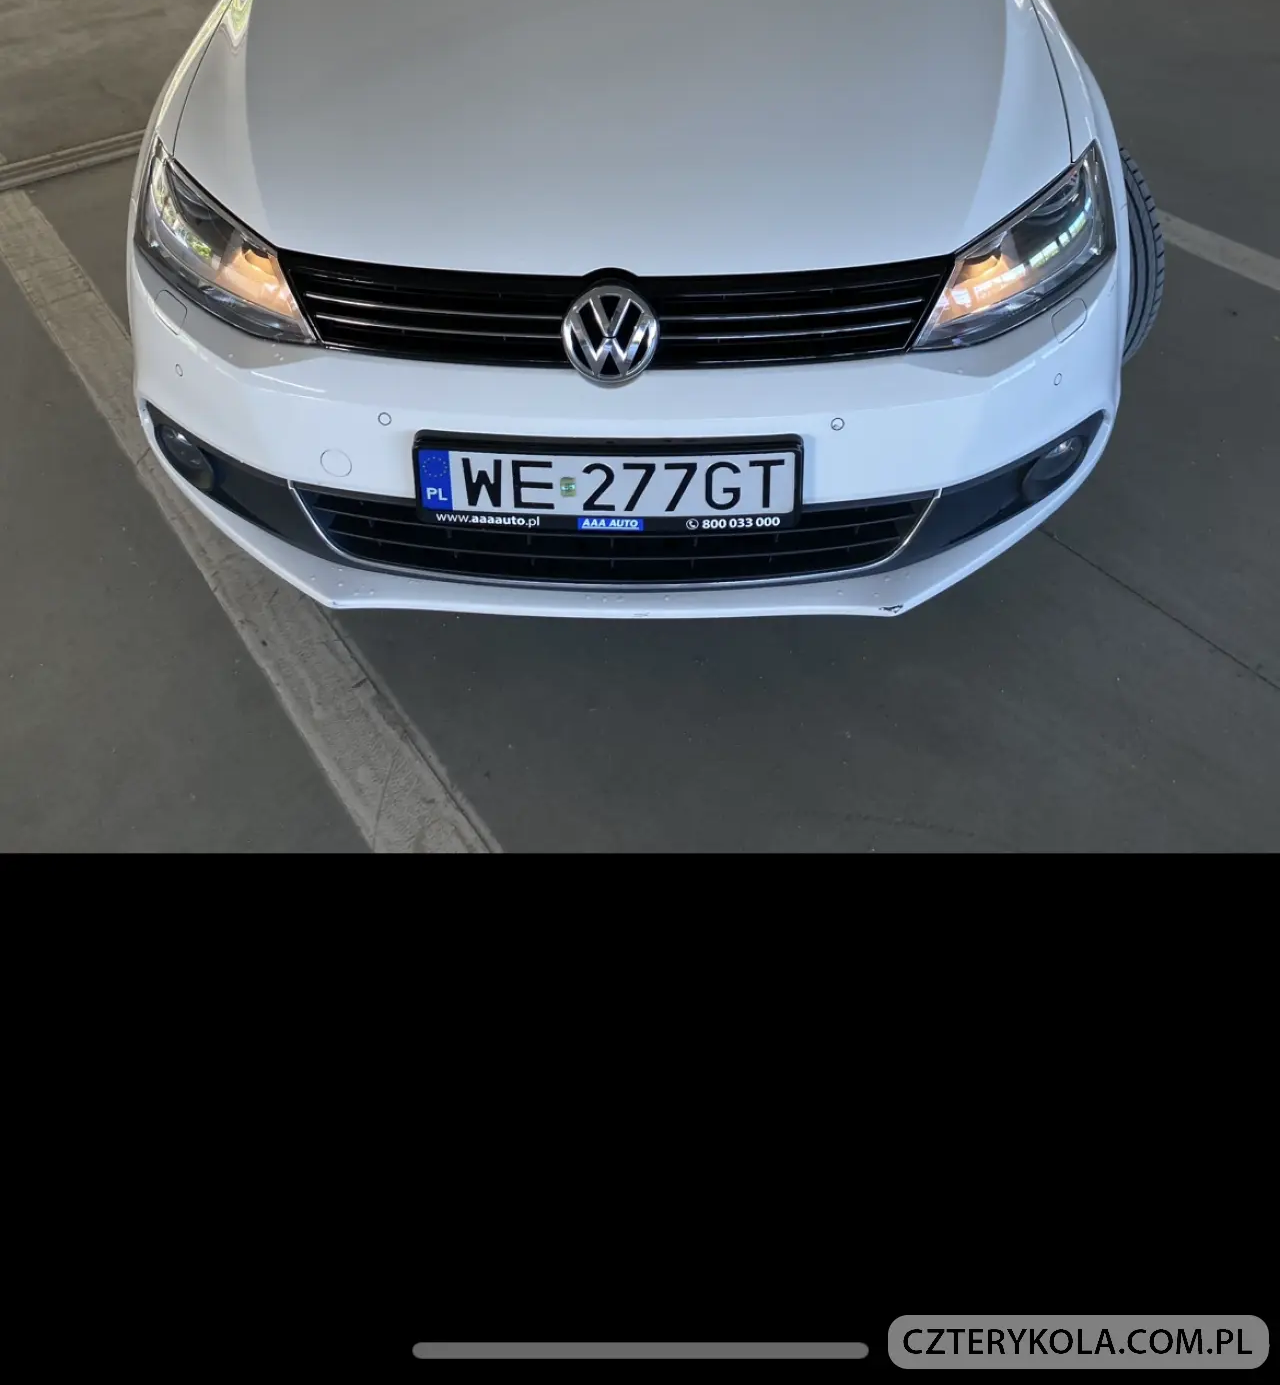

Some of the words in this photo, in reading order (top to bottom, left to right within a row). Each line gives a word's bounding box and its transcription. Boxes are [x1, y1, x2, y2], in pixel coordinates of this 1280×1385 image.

[561, 285, 660, 382] VW
[461, 456, 555, 510] WE
[582, 459, 785, 512] 277GT
[426, 487, 449, 502] PL
[436, 512, 540, 528] www.aaaauto.pl
[581, 518, 608, 530] AAA
[609, 518, 639, 530] AUTO
[701, 517, 728, 530] 800
[729, 517, 754, 529] 033
[755, 516, 781, 529] 000
